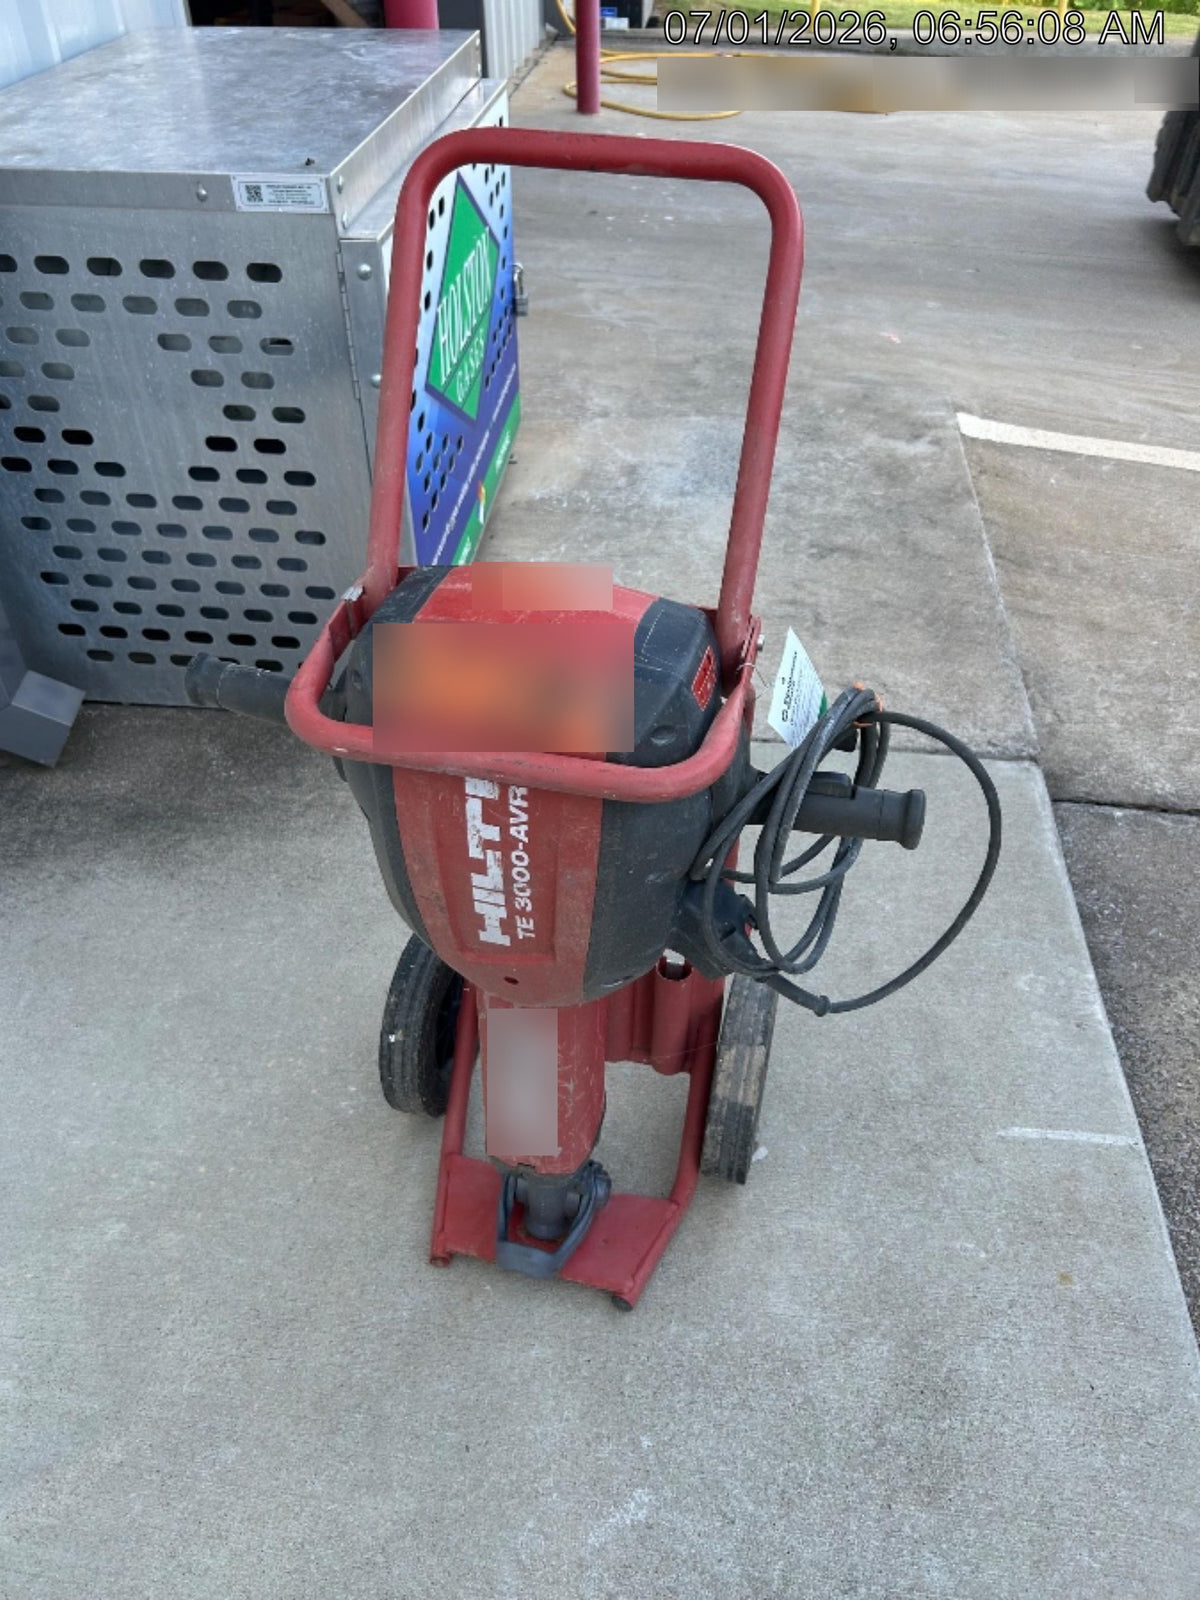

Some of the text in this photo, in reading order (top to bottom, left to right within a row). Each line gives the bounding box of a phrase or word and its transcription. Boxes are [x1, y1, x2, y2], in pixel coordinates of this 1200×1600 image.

[437, 226, 492, 387] HOLSTON
[456, 327, 485, 403] GASES
[465, 777, 511, 946] HILTI
[508, 785, 535, 939] TE 3000-AVR
